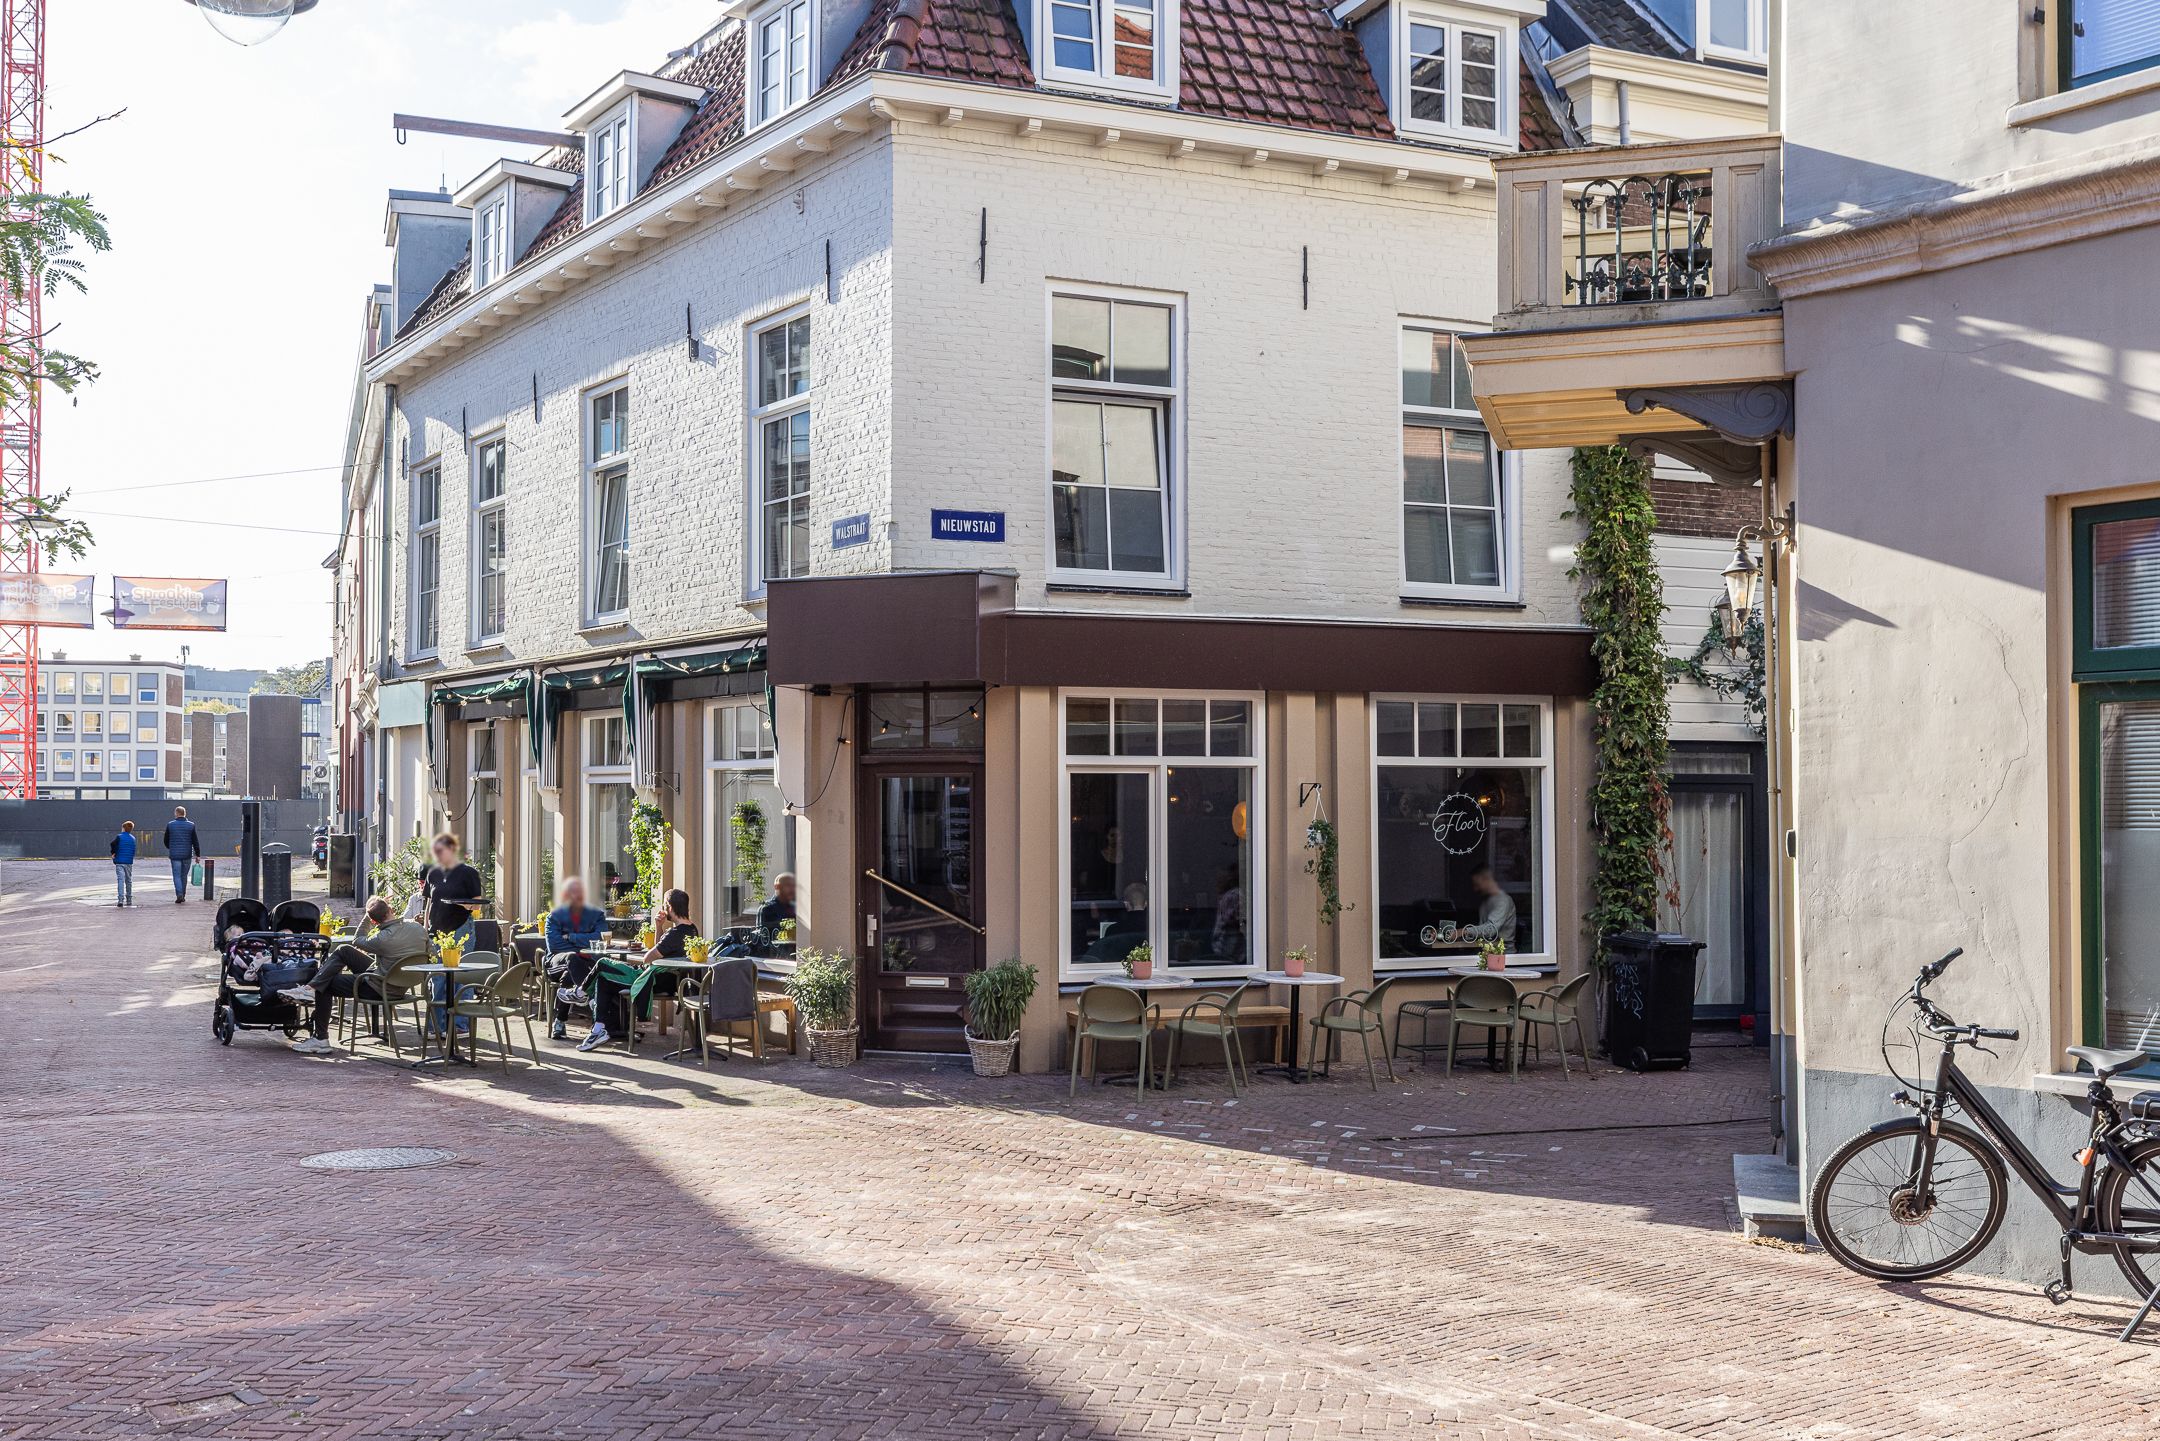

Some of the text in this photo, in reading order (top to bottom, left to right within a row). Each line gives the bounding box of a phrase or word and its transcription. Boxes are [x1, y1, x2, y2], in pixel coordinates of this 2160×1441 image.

[835, 522, 866, 540] WALSTRAAT
[940, 519, 996, 534] NIEUWSTAD
[1432, 810, 1488, 841] Floor
